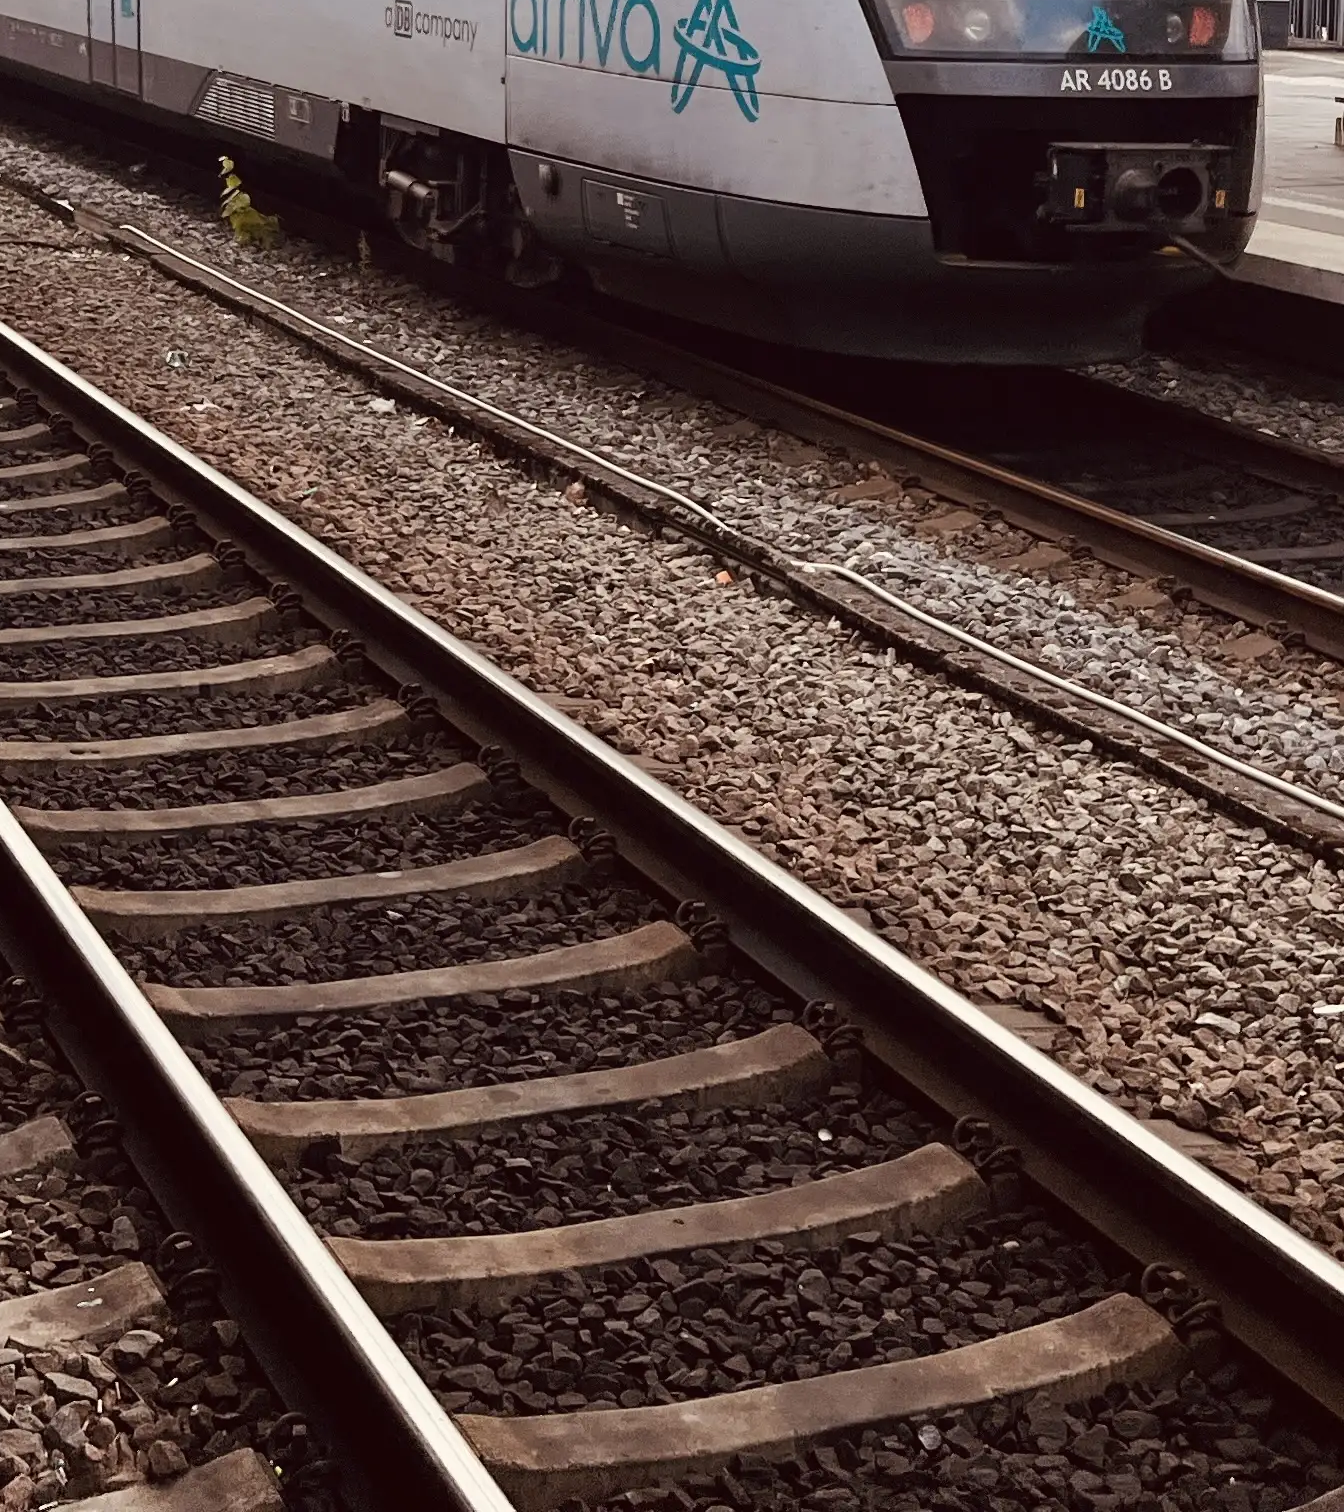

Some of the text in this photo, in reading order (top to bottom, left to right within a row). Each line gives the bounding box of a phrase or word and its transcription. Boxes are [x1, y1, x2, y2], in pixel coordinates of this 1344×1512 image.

[385, 0, 479, 52] a DB company
[1060, 69, 1173, 92] AR 4086 B
